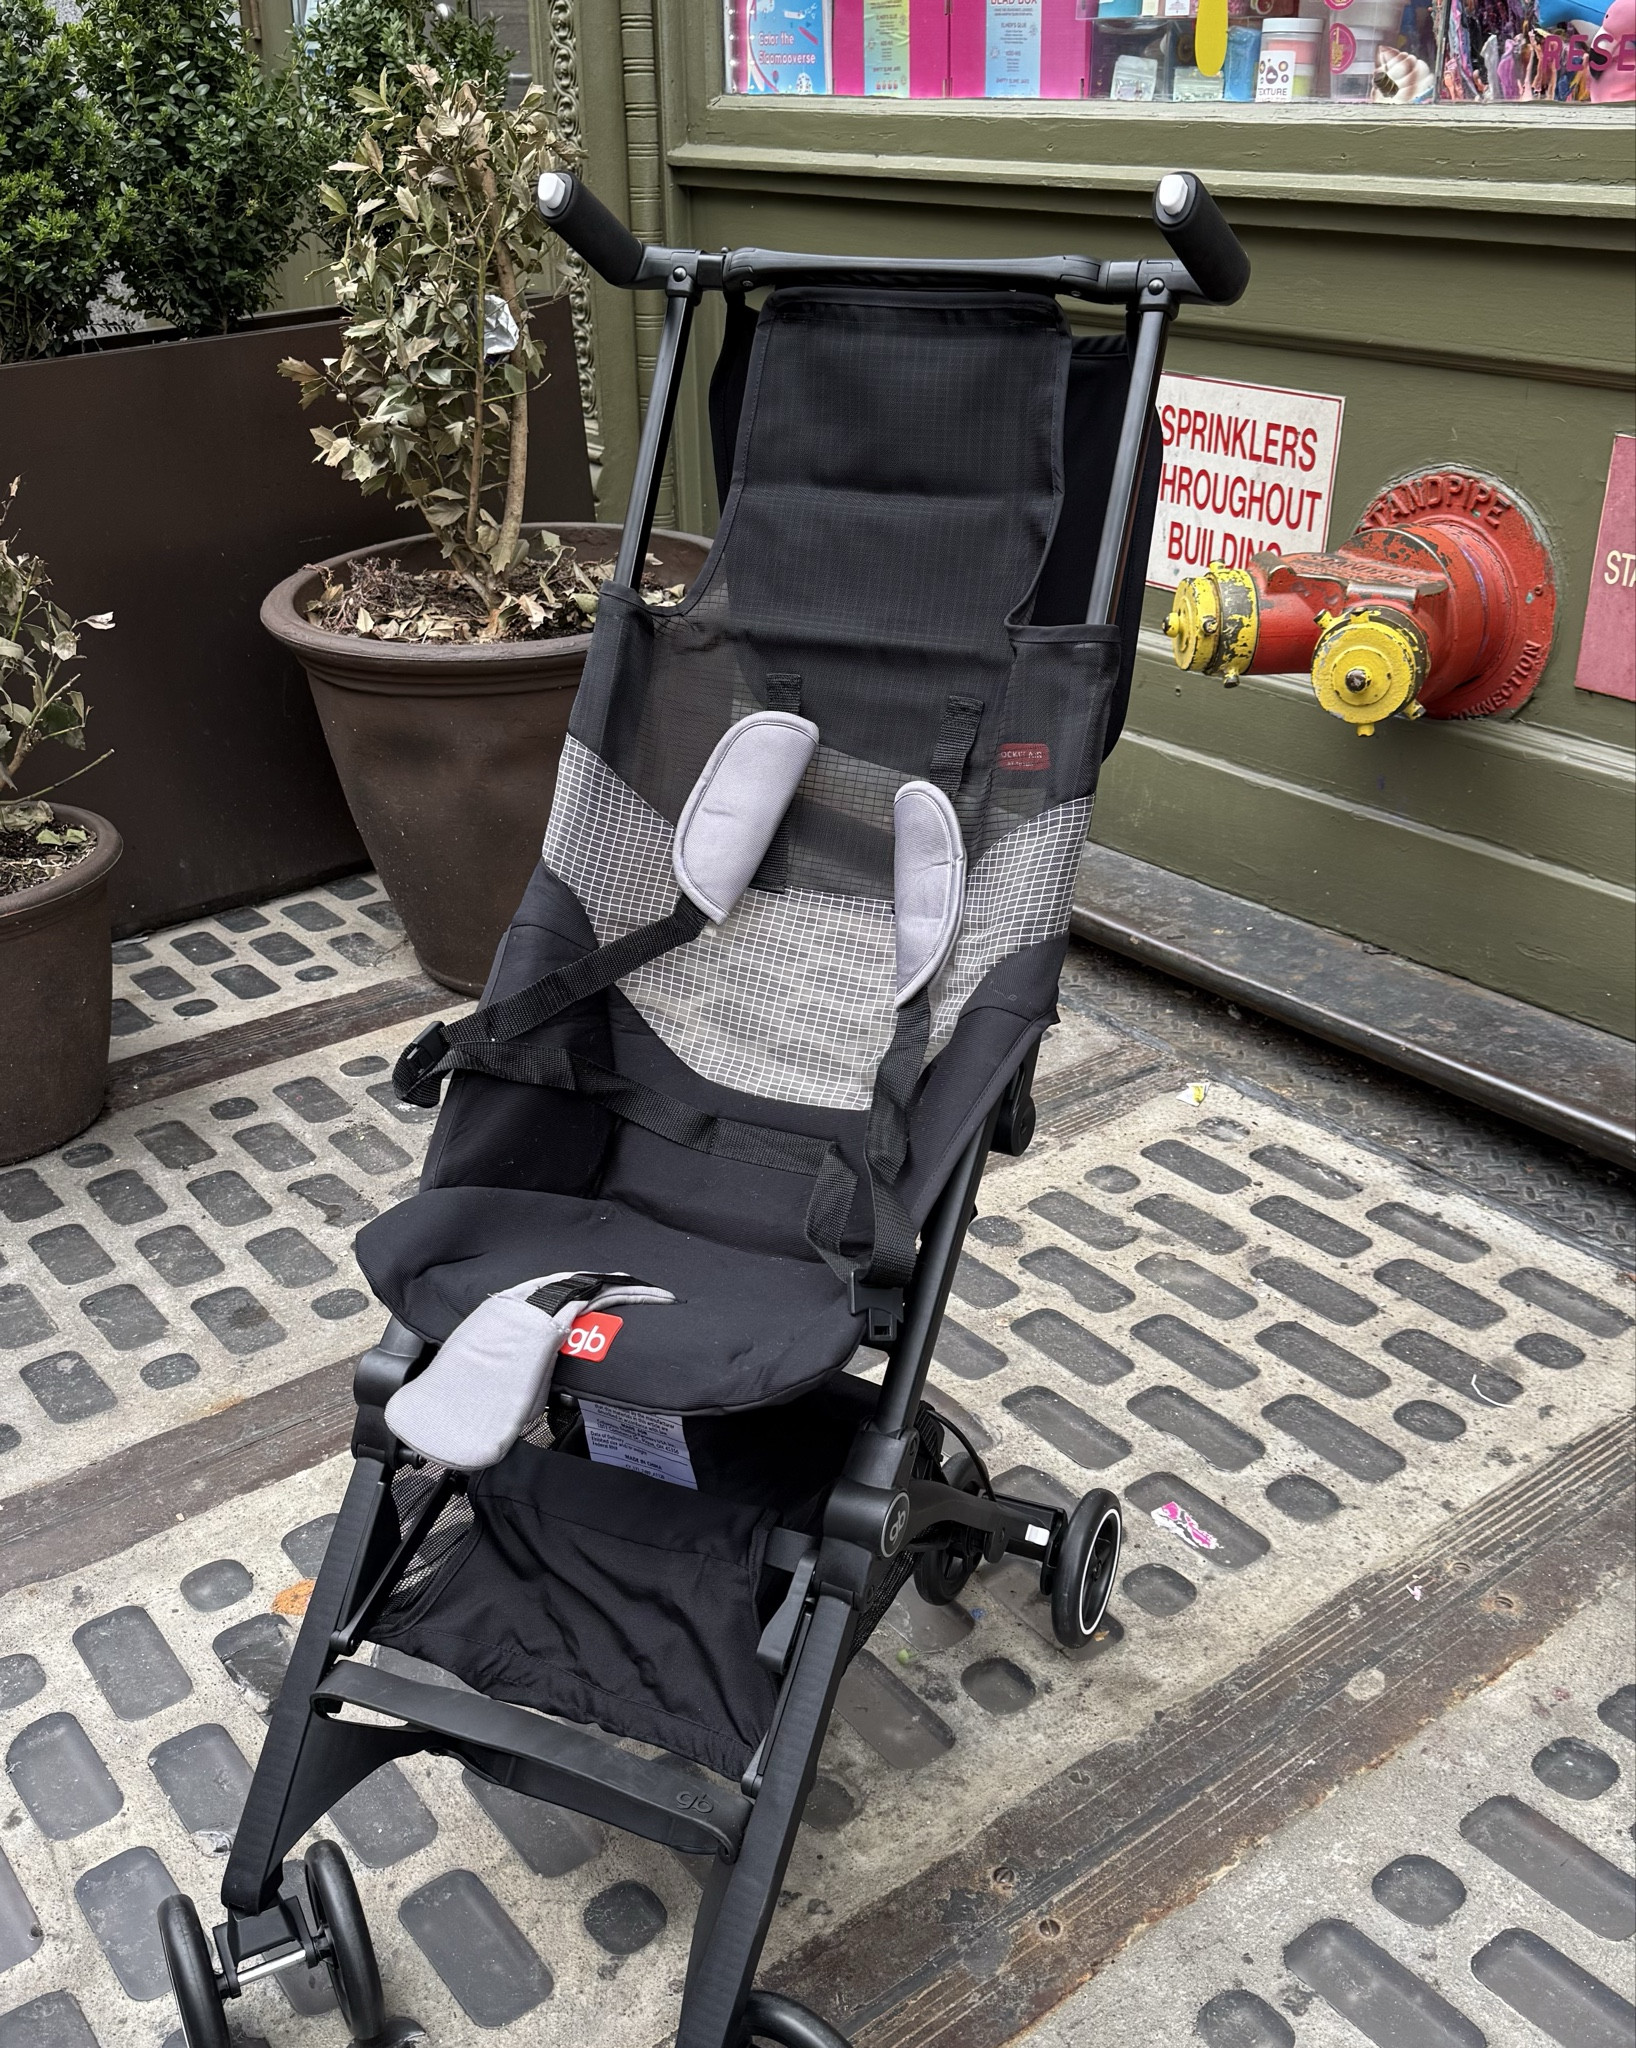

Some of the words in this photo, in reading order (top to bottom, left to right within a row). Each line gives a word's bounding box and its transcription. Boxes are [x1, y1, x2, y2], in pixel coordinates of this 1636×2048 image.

[758, 32, 779, 44] Color
[781, 32, 795, 44] the
[1162, 405, 1317, 472] SPRINKLERS
[1160, 463, 1322, 532] HROUGHOUT
[568, 1325, 605, 1355] gb
[624, 1453, 639, 1462] MADE
[646, 1460, 662, 1469] CHINA
